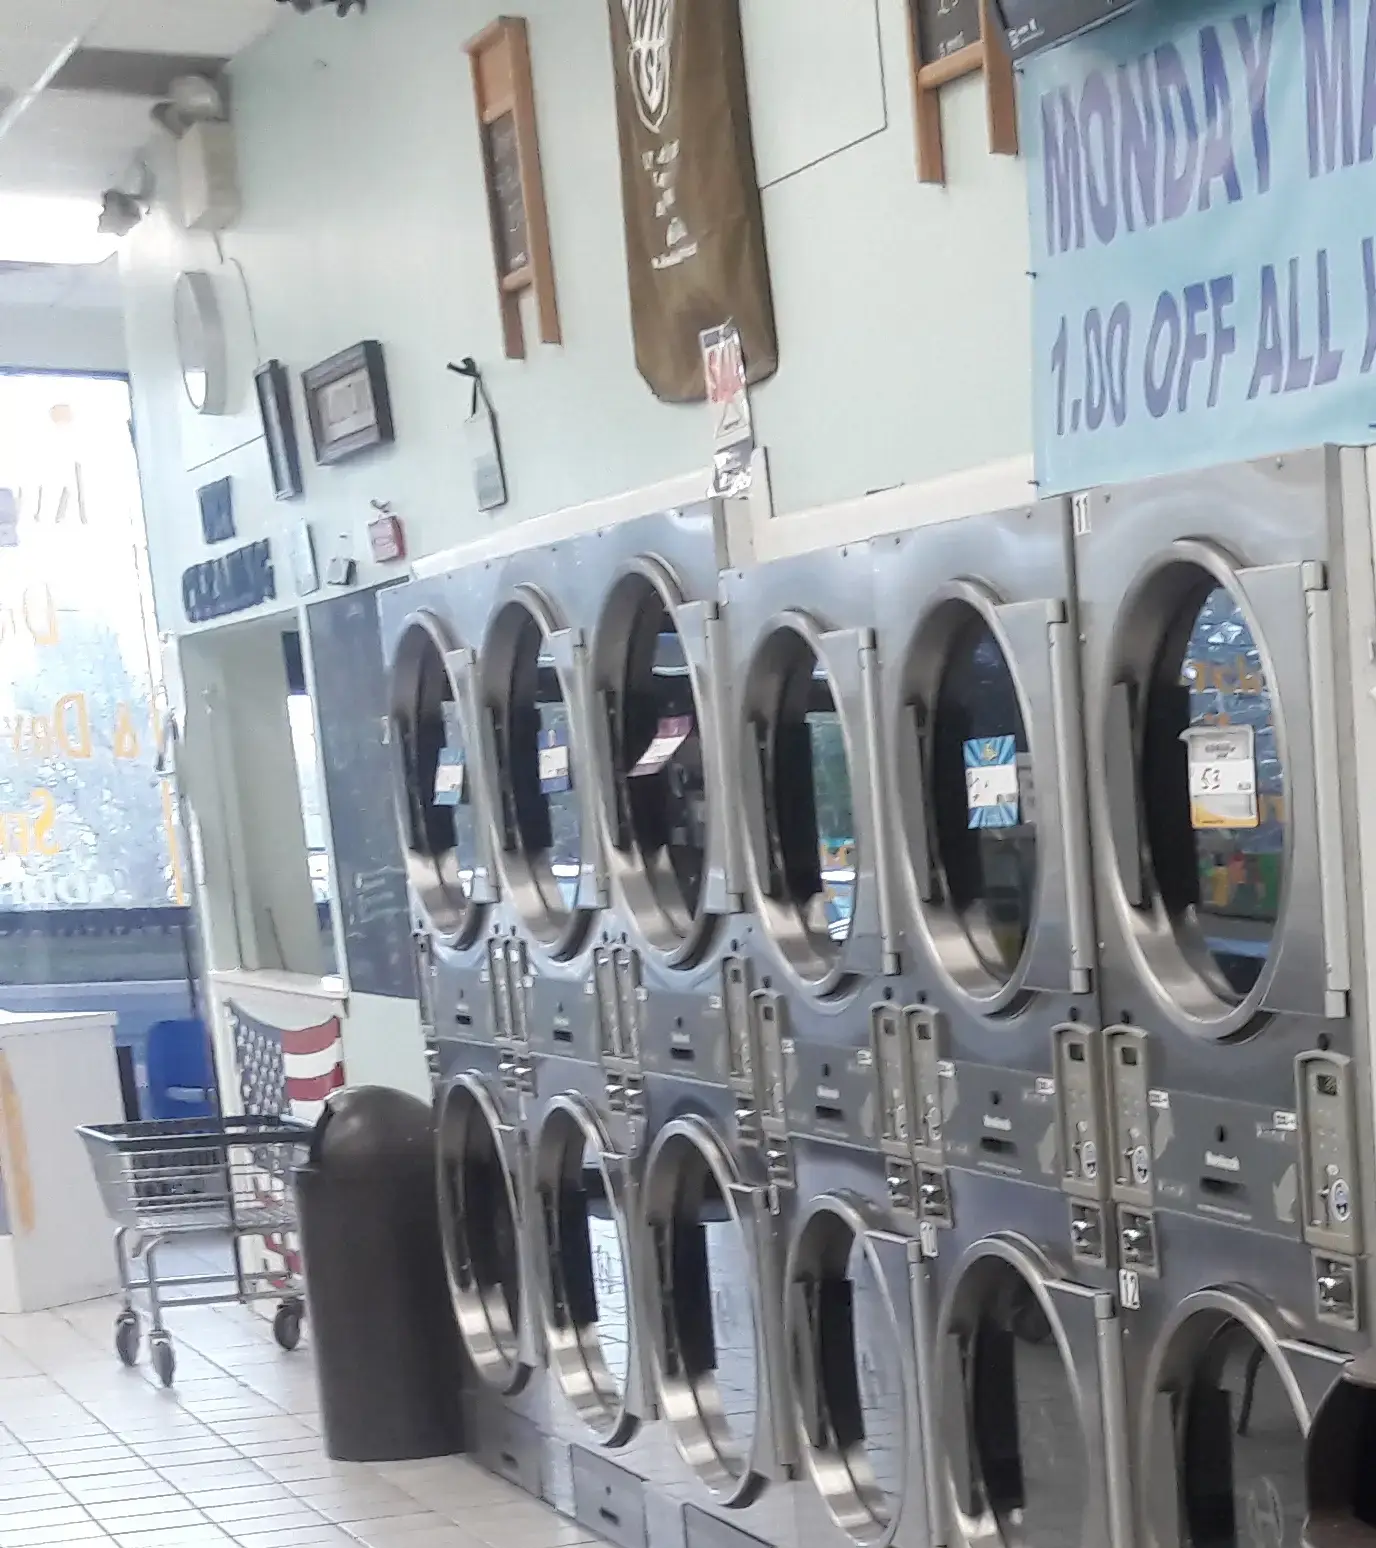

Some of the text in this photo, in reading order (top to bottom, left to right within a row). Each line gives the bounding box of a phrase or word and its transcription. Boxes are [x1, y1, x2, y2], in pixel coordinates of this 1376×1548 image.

[1042, 2, 1277, 257] MONDAY
[1050, 299, 1131, 435] 1.00
[1144, 272, 1238, 418] OFF
[1248, 252, 1343, 400] ALL
